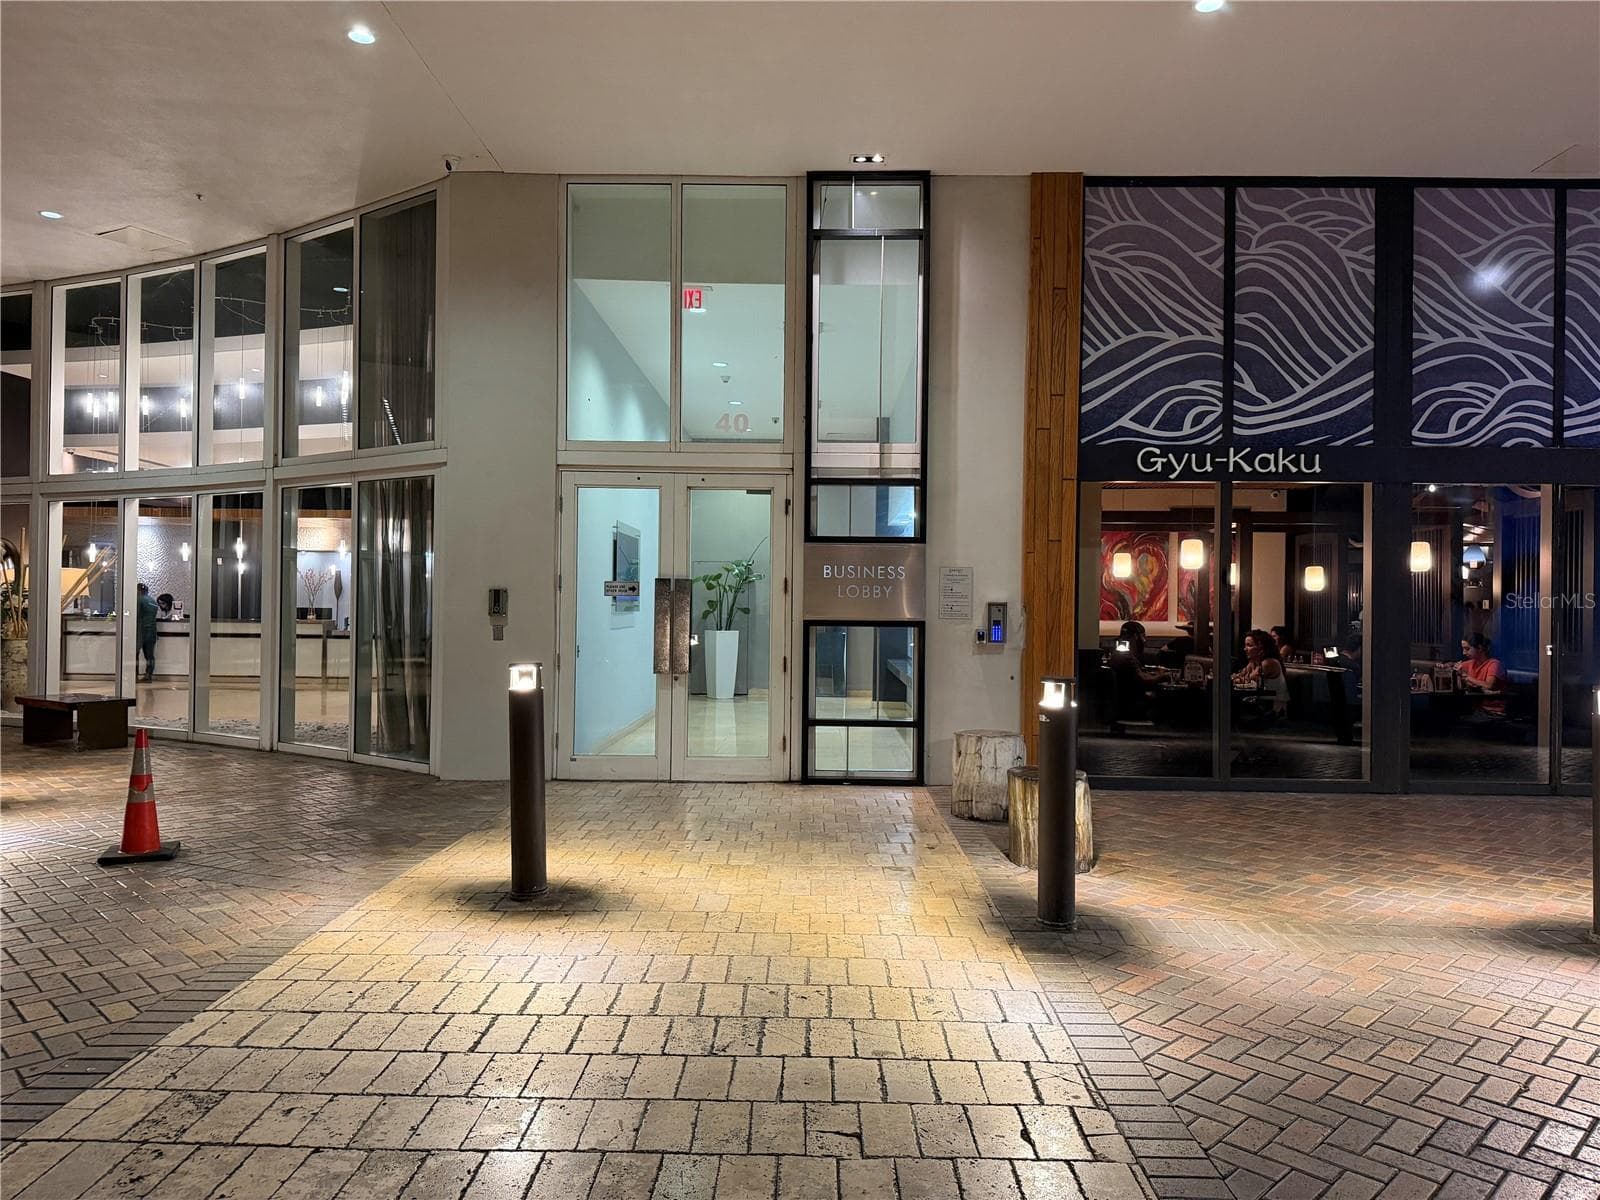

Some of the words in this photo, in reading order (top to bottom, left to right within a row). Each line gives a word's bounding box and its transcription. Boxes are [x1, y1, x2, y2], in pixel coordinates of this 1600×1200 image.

[715, 413, 750, 433] 40
[1136, 446, 1322, 480] Gyu-Kaku
[823, 565, 906, 580] BUSINESS
[838, 584, 892, 598] LOBBY
